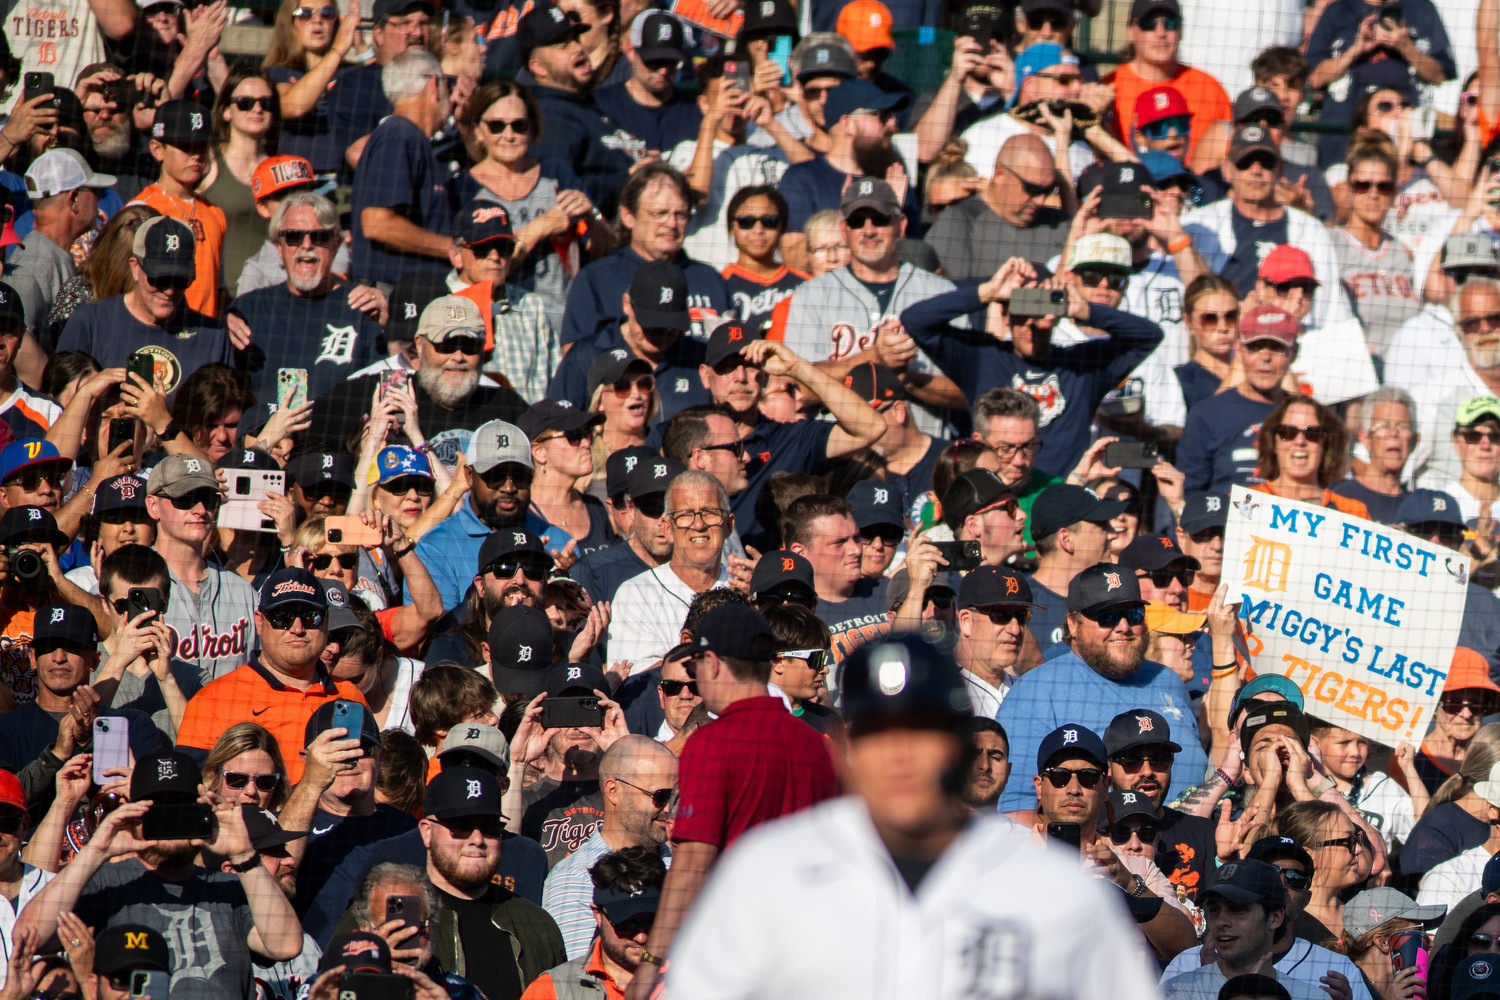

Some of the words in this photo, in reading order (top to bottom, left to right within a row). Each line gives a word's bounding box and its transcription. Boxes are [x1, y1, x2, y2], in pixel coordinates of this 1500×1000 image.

[14, 17, 77, 37] TIGERS
[190, 112, 203, 130] D
[166, 234, 180, 252] D
[318, 323, 357, 364] D
[728, 326, 743, 344] D
[24, 442, 41, 460] V
[184, 459, 201, 475] D
[322, 453, 334, 468] D
[654, 464, 668, 479] D
[874, 487, 888, 505] D
[513, 531, 527, 546] D
[1270, 505, 1325, 538] MY
[1340, 523, 1436, 577] FIRST
[1242, 534, 1292, 593] D
[1104, 572, 1122, 592] D
[1314, 573, 1405, 627] GAME
[51, 606, 65, 624] D
[829, 612, 889, 633] DETROIT
[518, 644, 532, 662] D
[1238, 594, 1363, 664] MIGGY'S
[1367, 646, 1447, 697] LAST
[567, 666, 581, 681] D
[1281, 653, 1424, 738] TIGERS!
[1135, 716, 1153, 734] D
[1063, 730, 1078, 745] D
[465, 779, 482, 799] D
[564, 807, 604, 818] DETROIT
[125, 932, 149, 949] M
